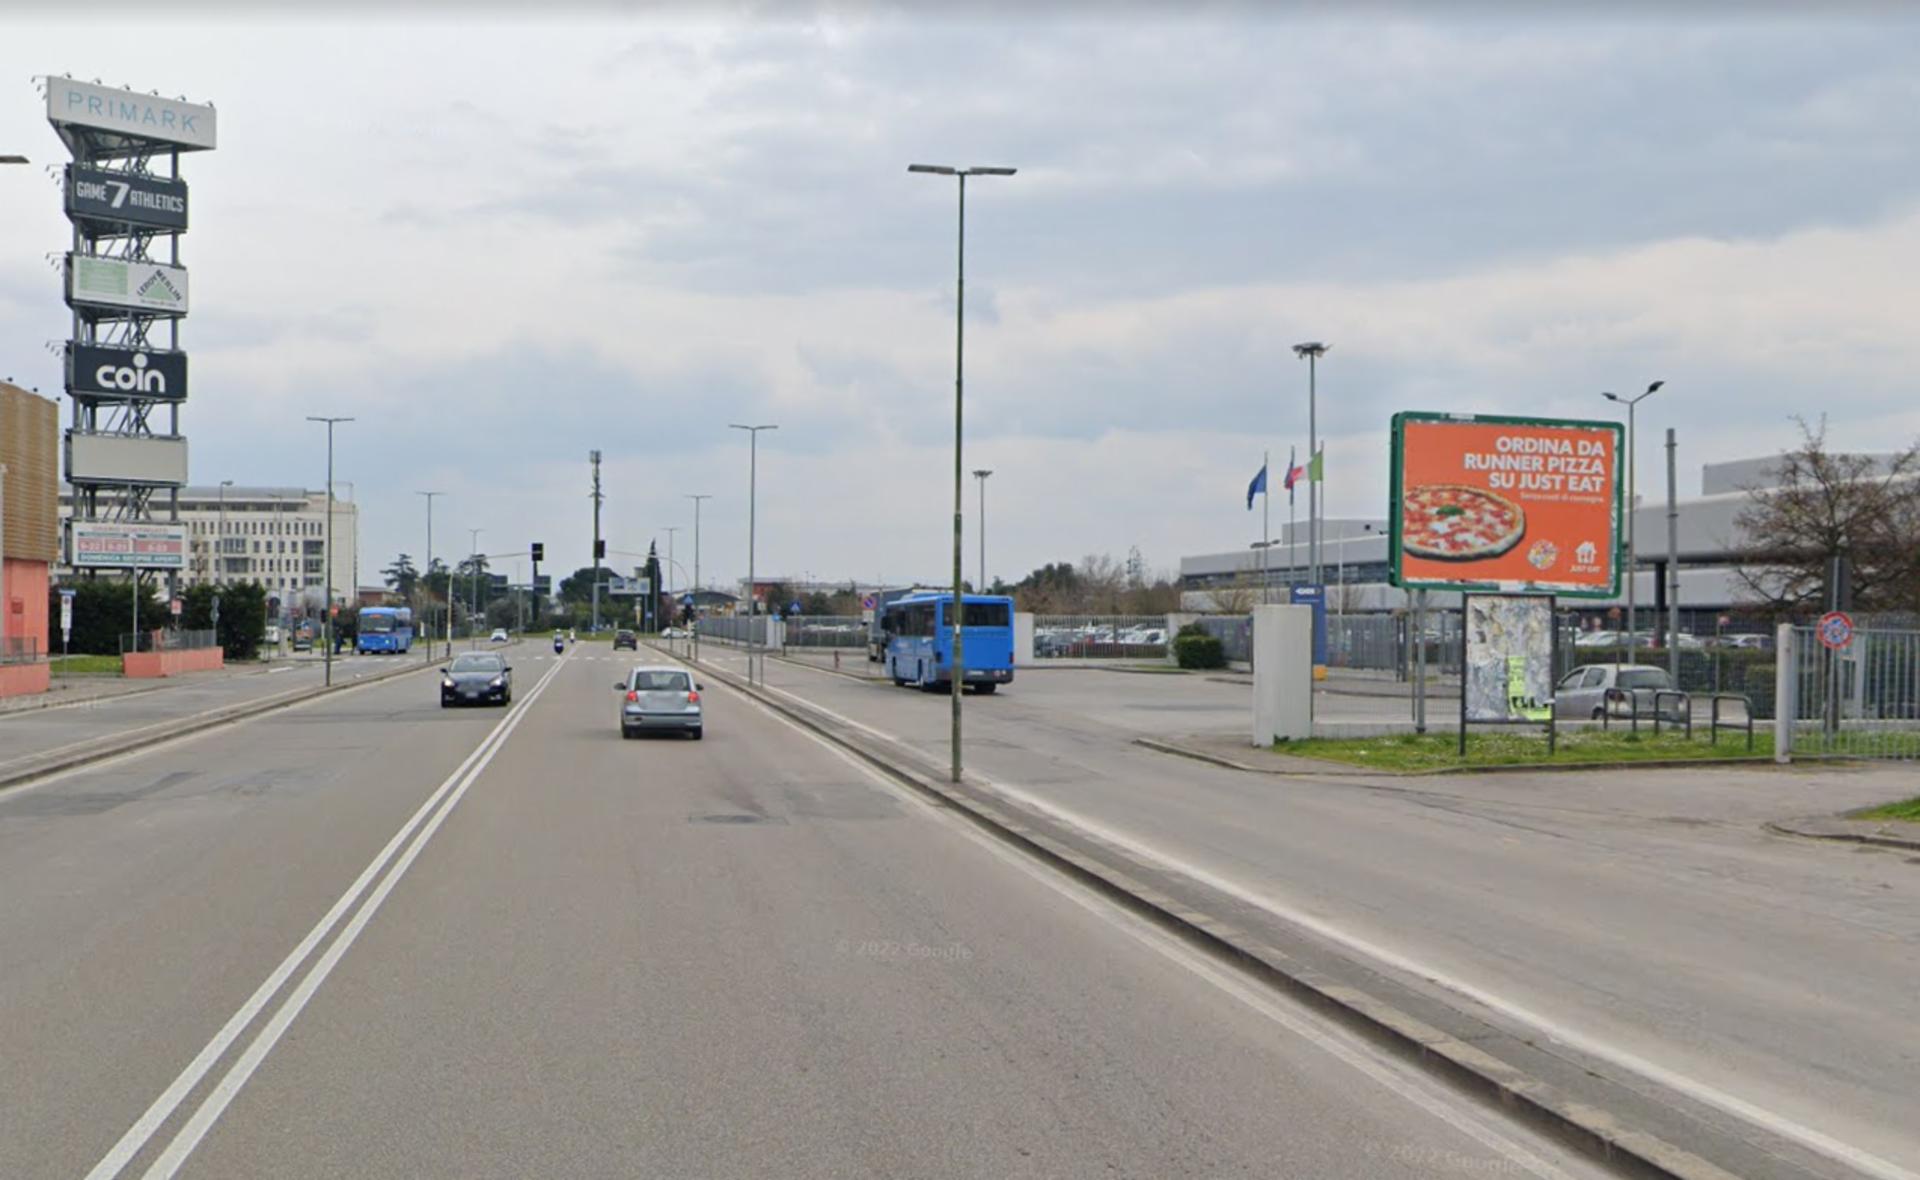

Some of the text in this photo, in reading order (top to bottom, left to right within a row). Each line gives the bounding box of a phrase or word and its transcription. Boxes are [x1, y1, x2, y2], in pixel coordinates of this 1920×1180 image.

[66, 90, 196, 134] PRIMARK
[76, 180, 184, 213] GAME 7 ATHLETICS
[136, 275, 157, 297] LEROY
[156, 269, 181, 301] MERLIN
[96, 353, 166, 393] coin
[1496, 435, 1605, 457] ORDINA DA
[1464, 453, 1605, 475] RUNNER PIZZA
[1488, 471, 1605, 493] SU JUST EAT
